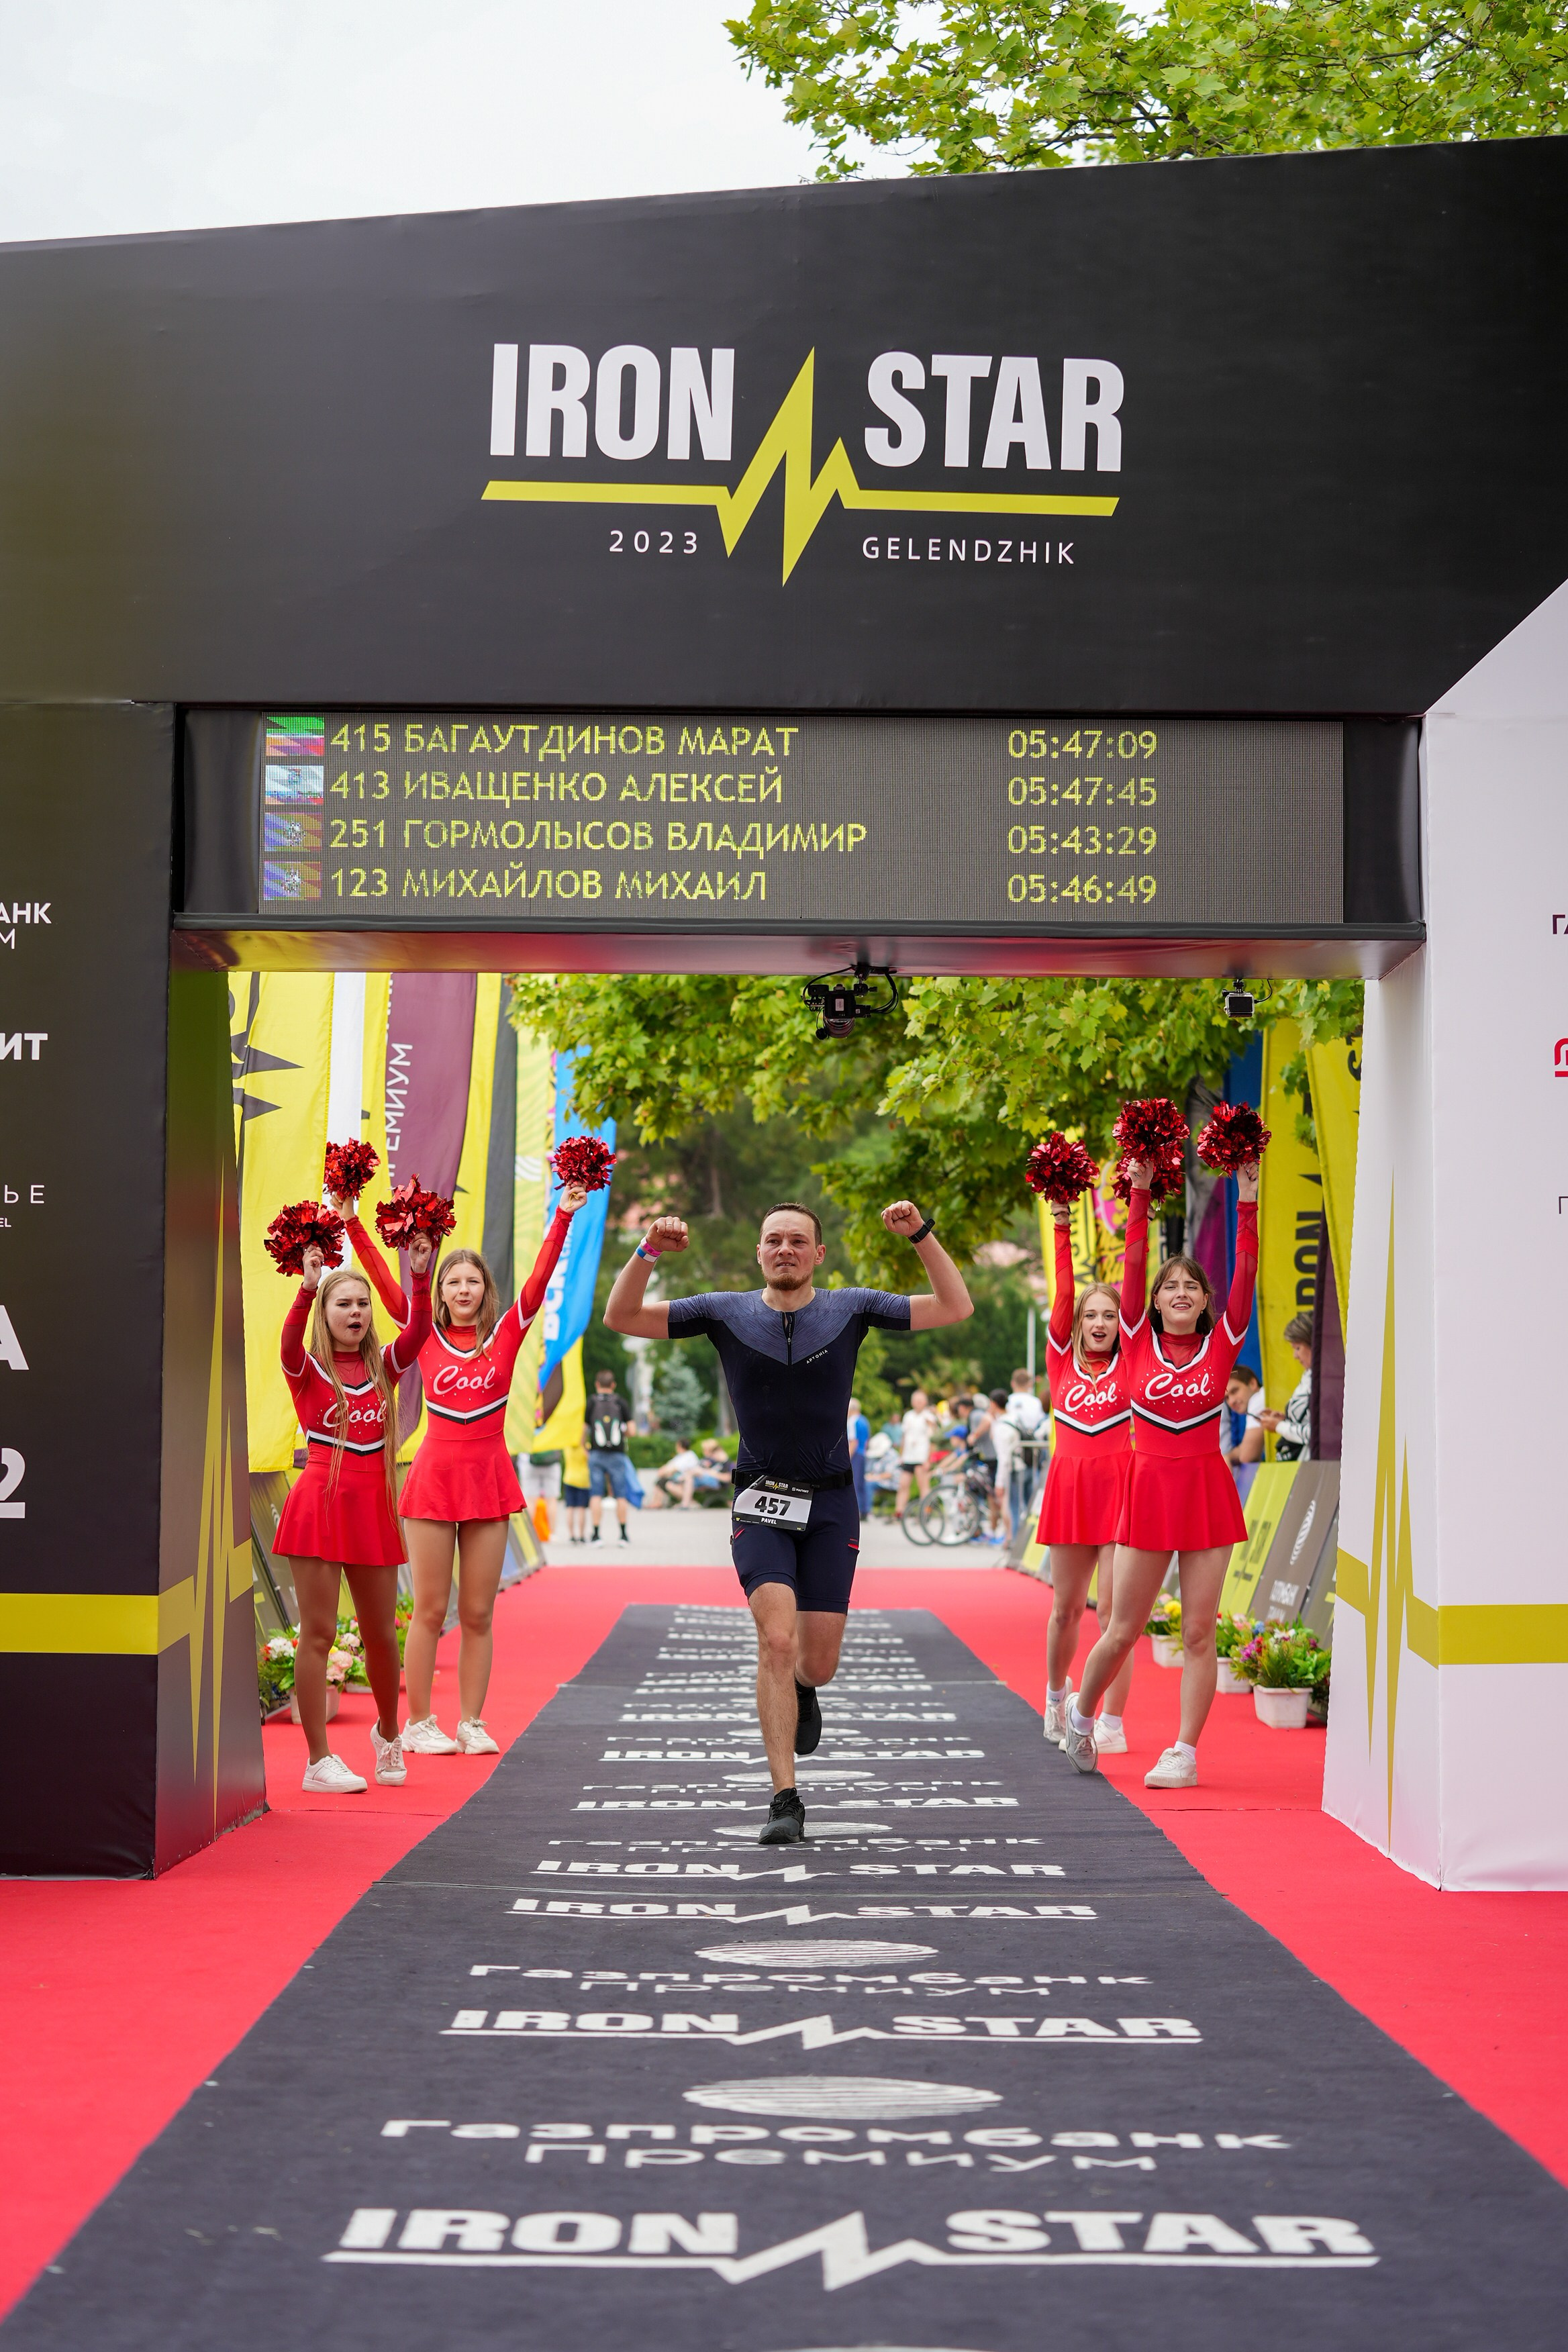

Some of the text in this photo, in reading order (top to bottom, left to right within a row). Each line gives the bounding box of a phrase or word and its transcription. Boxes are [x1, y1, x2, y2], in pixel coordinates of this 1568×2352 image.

[489, 343, 1124, 473] IRON STAR
[608, 529, 698, 554] 2023
[862, 536, 1075, 565] GELENDZHIK
[331, 723, 1158, 761] 415 БАГАУТДИНОВ МАРАТ 05:47:09
[330, 766, 1158, 807] 413 ИВАЩЕНКО АЛЕКСЕЙ 05:47:45
[330, 818, 1158, 859] 251 ГОРМОЛЫСОВ ВЛАДИМИР 05:43:29
[331, 861, 1157, 903] 123 МИХАЙЛОВ МИХАИЛ 05:46:49
[806, 1349, 828, 1364] APTONIA
[433, 1365, 496, 1395] Cool
[1145, 1373, 1211, 1401] Cool
[1064, 1382, 1118, 1412] Cool
[754, 1496, 791, 1516] 457
[761, 1517, 777, 1525] PAVEL
[603, 1749, 985, 1759] IRON STAR
[575, 1797, 1020, 1809] IRON STAR
[548, 1838, 1046, 1847] Газпрмбанк
[536, 1860, 1066, 1876] IRON STAR
[511, 1898, 1098, 1916] IRON STAR
[469, 1965, 1154, 1984] Газпромбанк
[579, 1981, 1052, 1996] Премиум
[451, 2009, 1203, 2038] IRON STAR
[379, 2118, 1294, 2150] Газпромбанк
[524, 2143, 1158, 2173] Премиум
[338, 2207, 1375, 2257] IRON STAR
